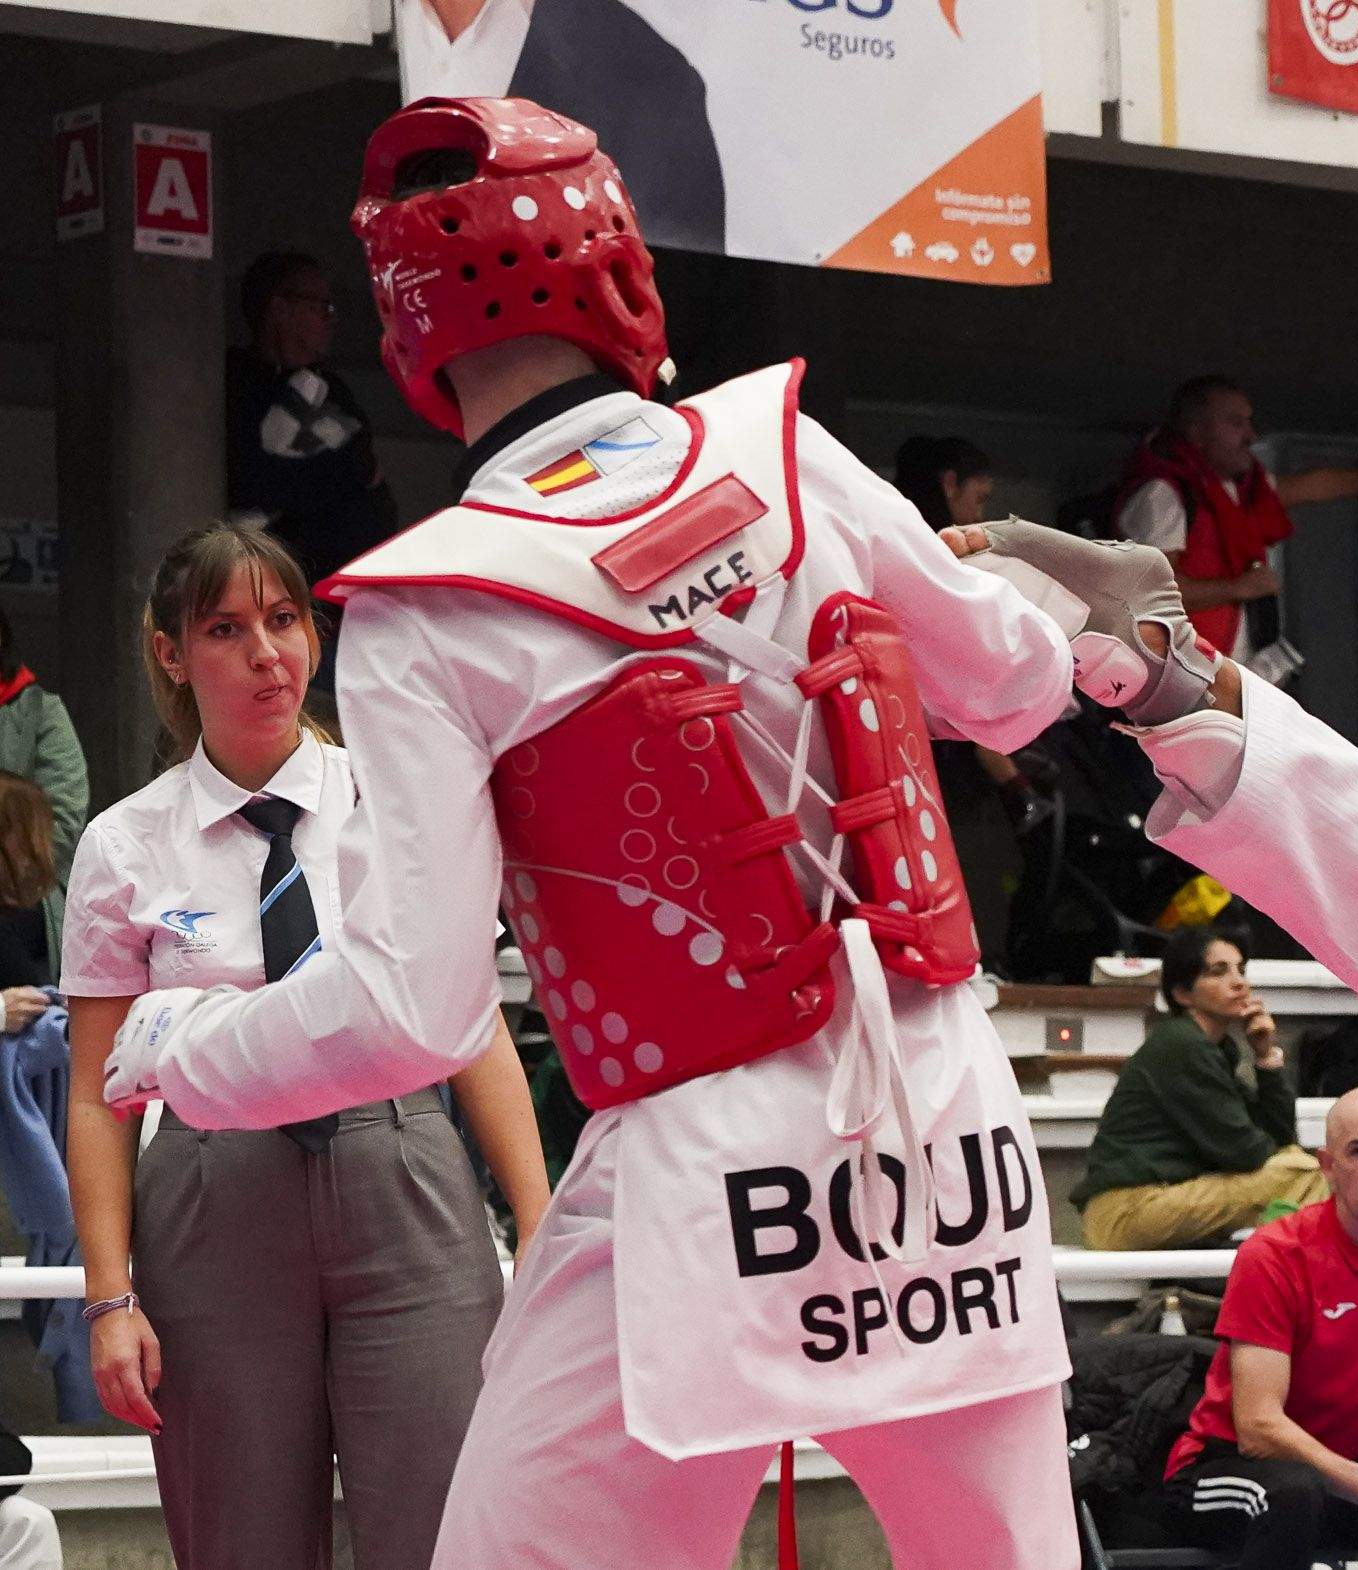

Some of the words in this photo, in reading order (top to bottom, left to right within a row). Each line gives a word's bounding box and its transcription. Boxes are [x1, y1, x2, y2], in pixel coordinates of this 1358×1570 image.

[801, 23, 895, 60] Seguros
[62, 140, 94, 202] A
[147, 158, 198, 221] A
[648, 550, 753, 629] MACE
[724, 1125, 1032, 1277] BOUD
[800, 1257, 1022, 1363] SPORT
